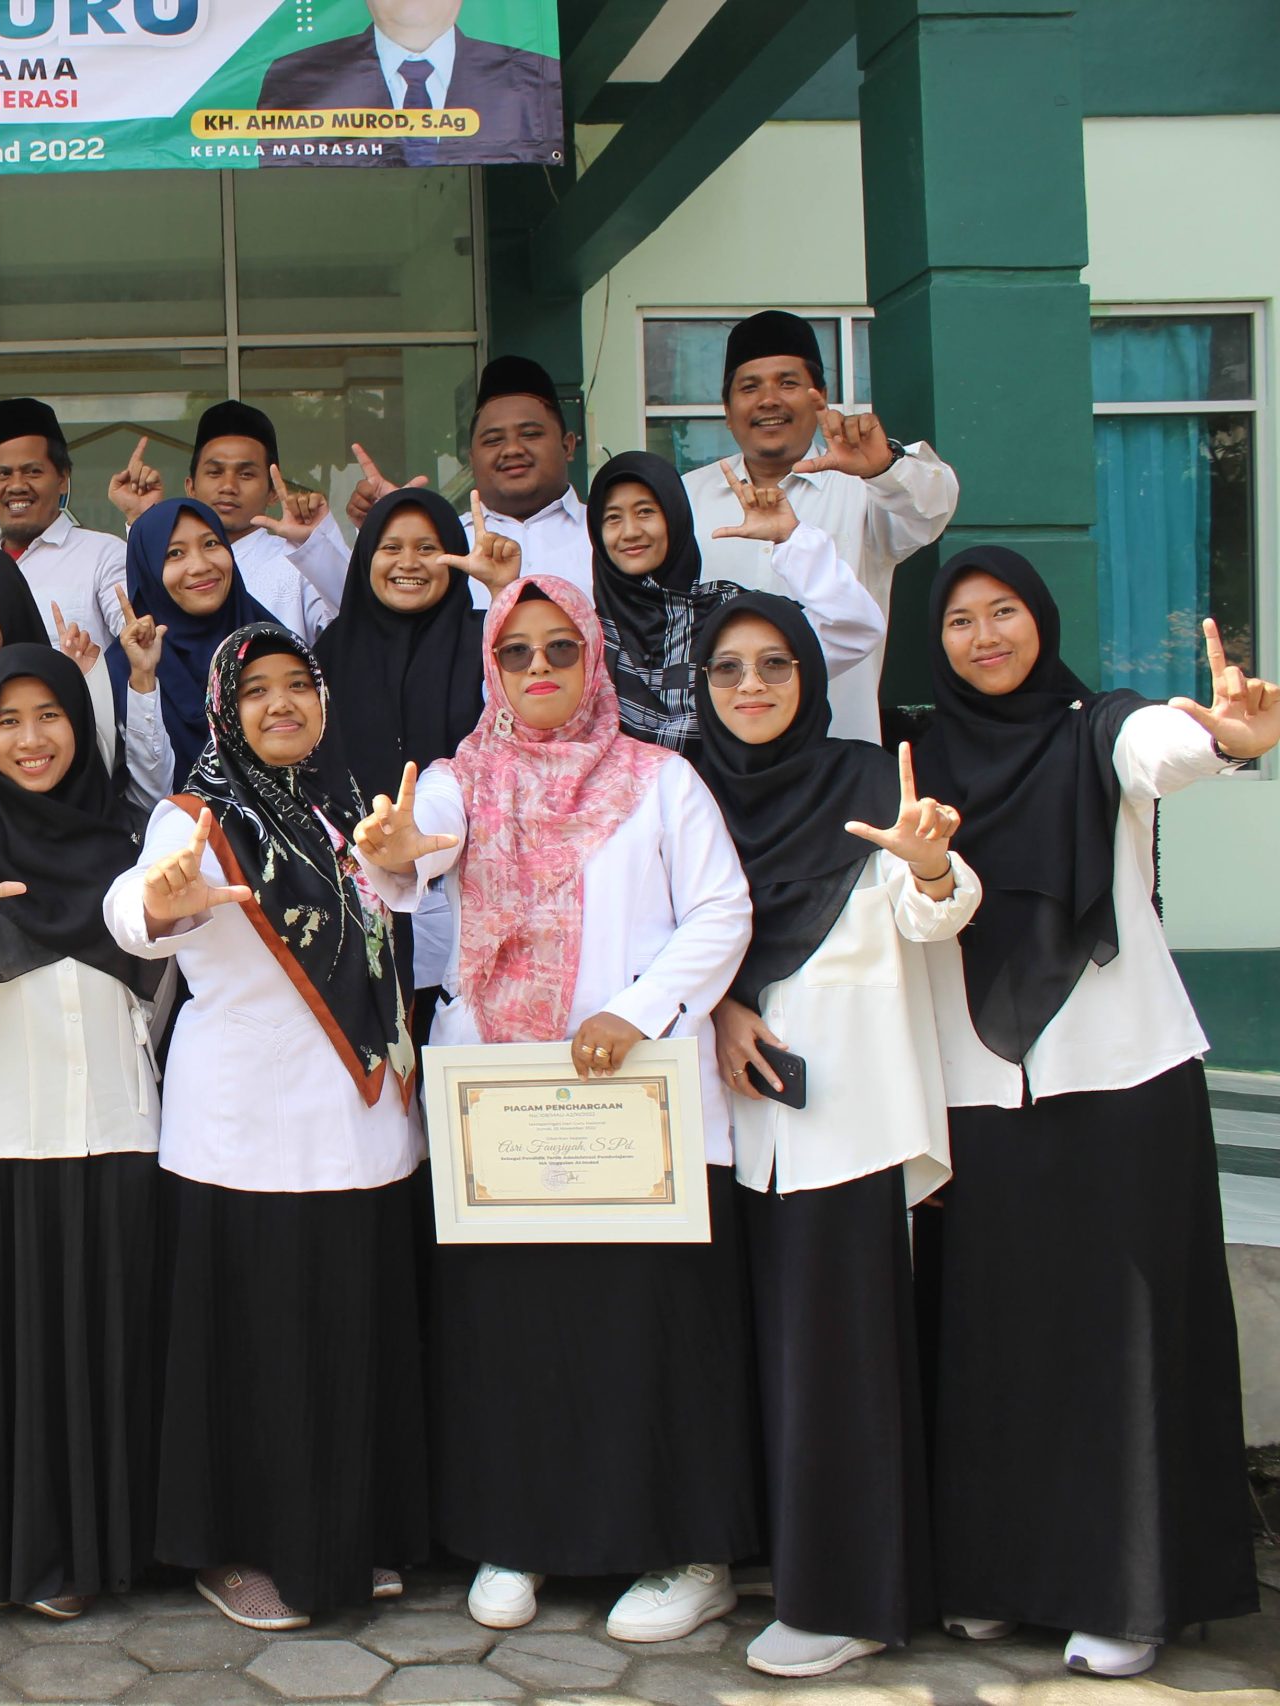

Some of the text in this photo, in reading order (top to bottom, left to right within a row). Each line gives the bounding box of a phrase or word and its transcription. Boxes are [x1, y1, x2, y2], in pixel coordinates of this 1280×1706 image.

[204, 112, 466, 131] KH. AHMAD MUROD, S.Ag
[29, 137, 106, 162] 2022
[191, 143, 384, 157] KEPALA MADRASAH
[545, 1103, 623, 1111] PENGHARGAAN
